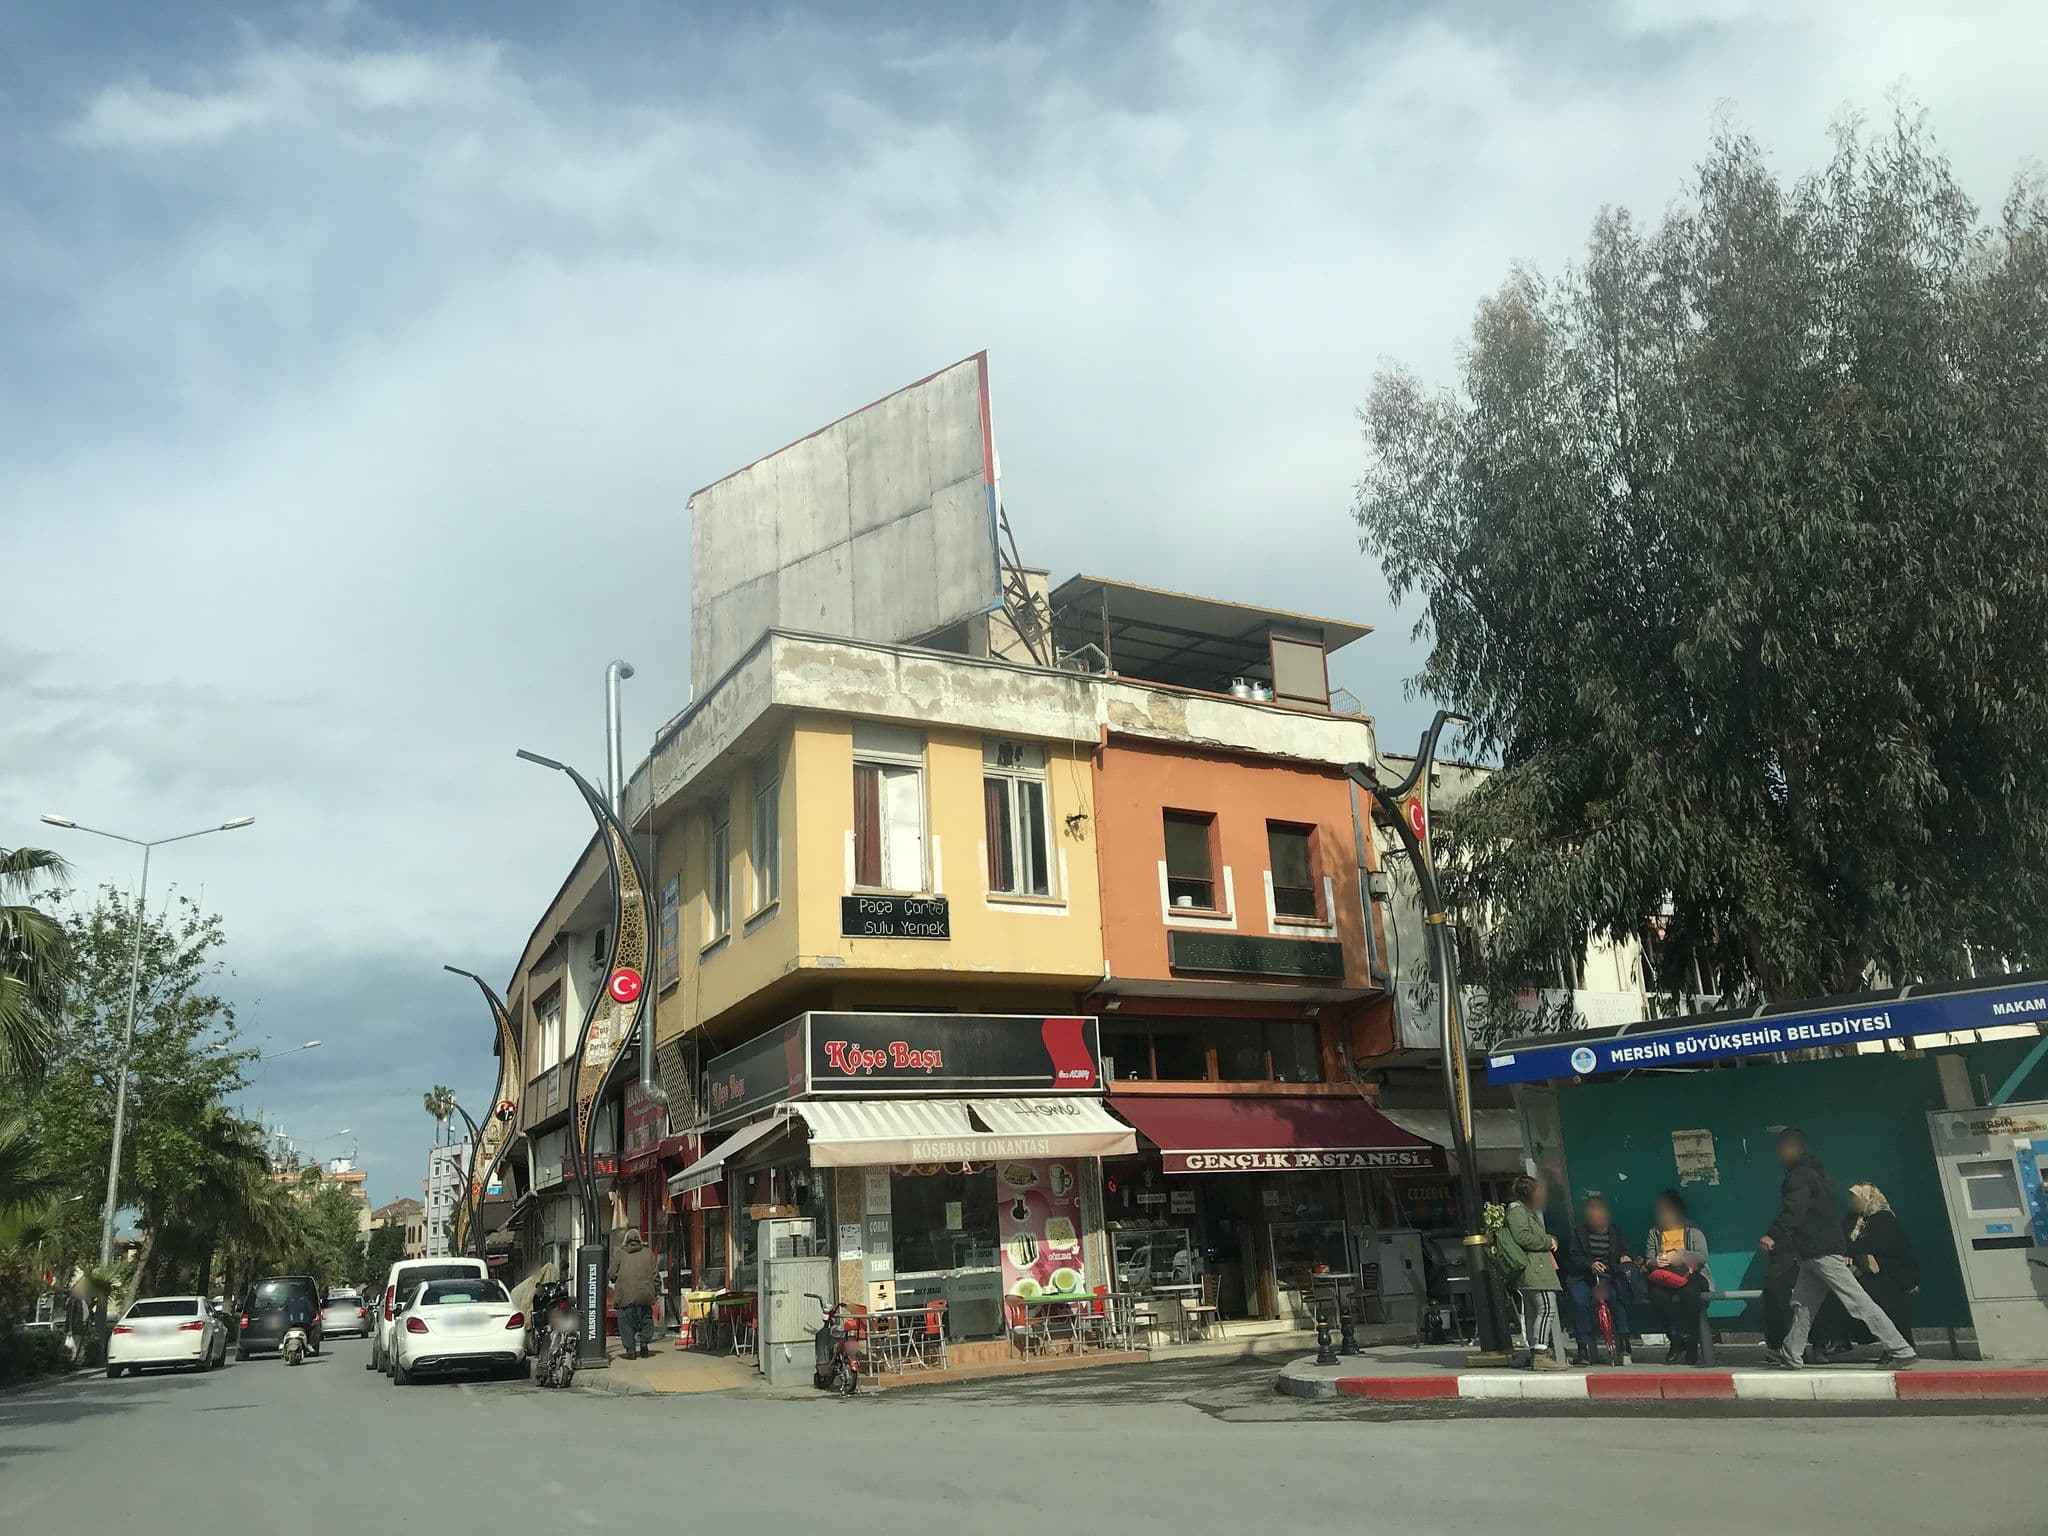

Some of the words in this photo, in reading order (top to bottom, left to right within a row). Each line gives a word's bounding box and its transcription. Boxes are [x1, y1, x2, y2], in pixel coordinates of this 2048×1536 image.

[859, 899, 893, 915] Paça
[864, 920, 894, 935] Sulu
[900, 920, 945, 936] Yemek
[1992, 998, 2047, 1016] MAKAM
[1610, 1041, 1671, 1063] MERSİN
[1675, 1027, 1783, 1055] BÜYÜKŞEHİR
[1786, 1012, 1893, 1042] BELEDİYESİ
[824, 1040, 887, 1076] Köşe
[888, 1040, 944, 1074] Başı
[912, 1141, 977, 1160] KÖŞEBAŞI
[981, 1138, 1050, 1157] LOKANTASI
[1185, 1153, 1292, 1171] GENÇLİK
[1295, 1151, 1420, 1168] PASTANESİ
[588, 1310, 597, 1341] TARSUS
